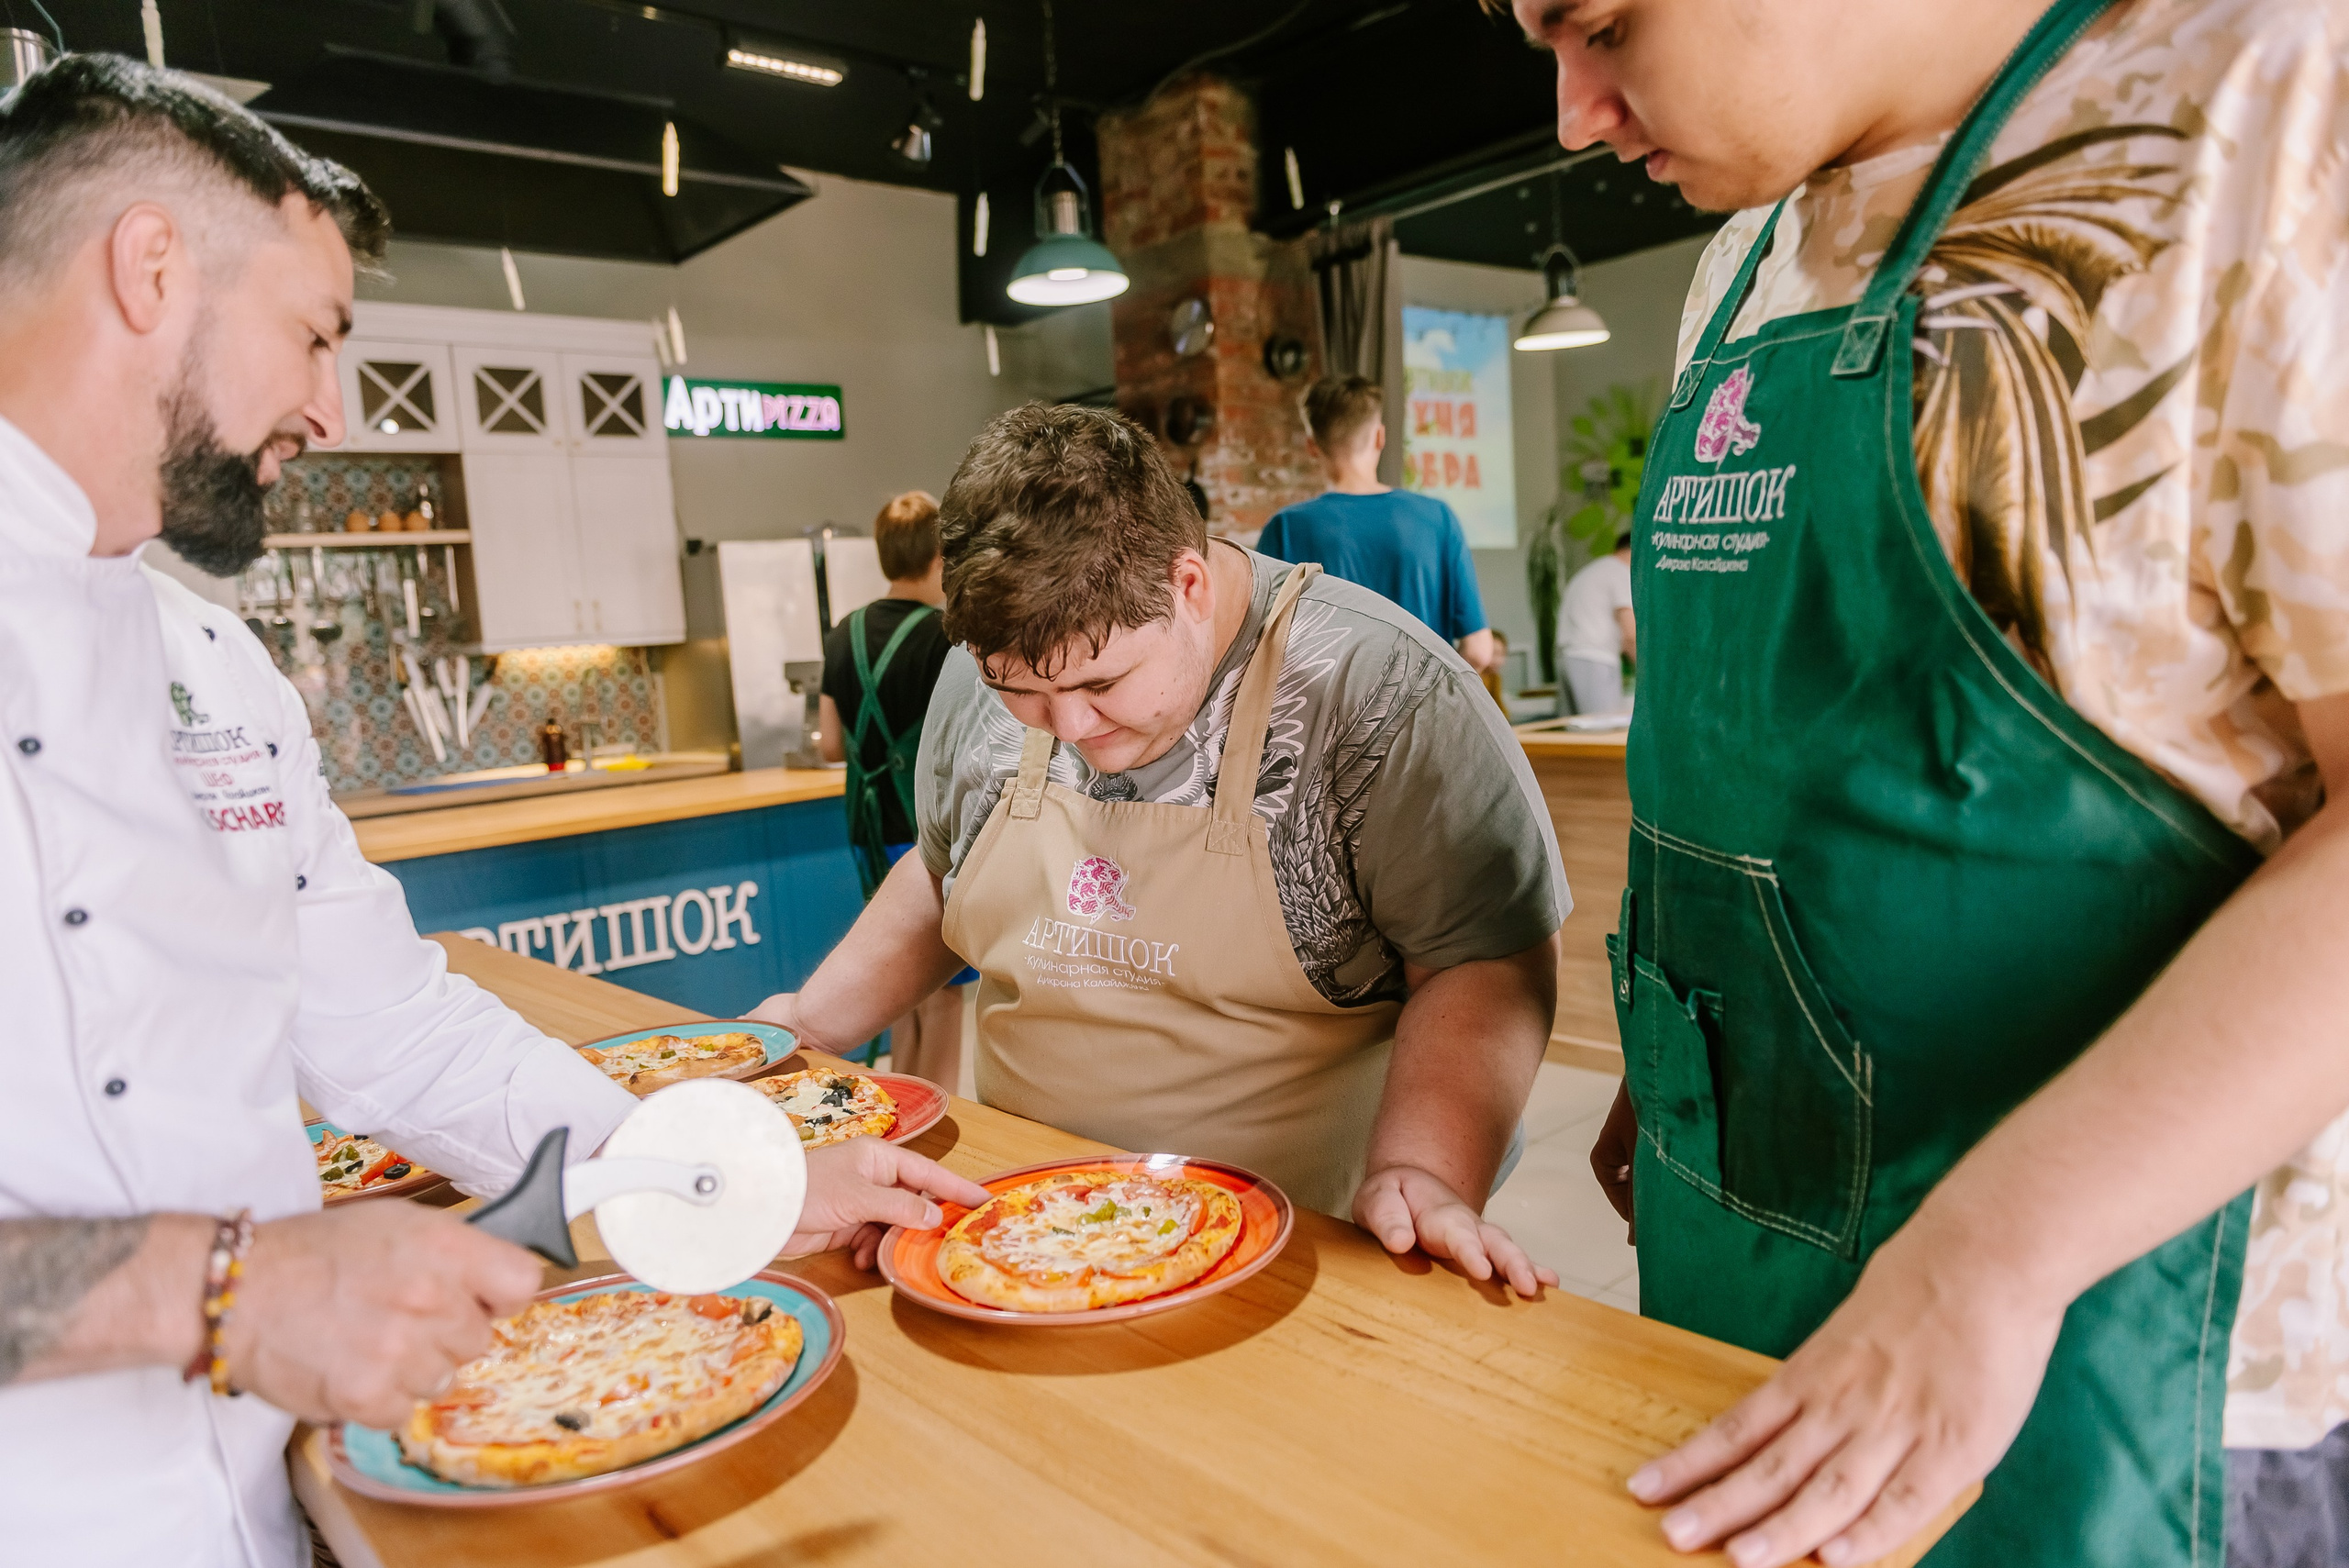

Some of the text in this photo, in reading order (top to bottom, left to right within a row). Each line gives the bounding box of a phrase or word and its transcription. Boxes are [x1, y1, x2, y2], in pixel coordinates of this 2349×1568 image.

[1653, 464, 1797, 524] АРТИШОК
[459, 880, 761, 975] ТИШОК
[1021, 916, 1180, 977] АРТИШОК
